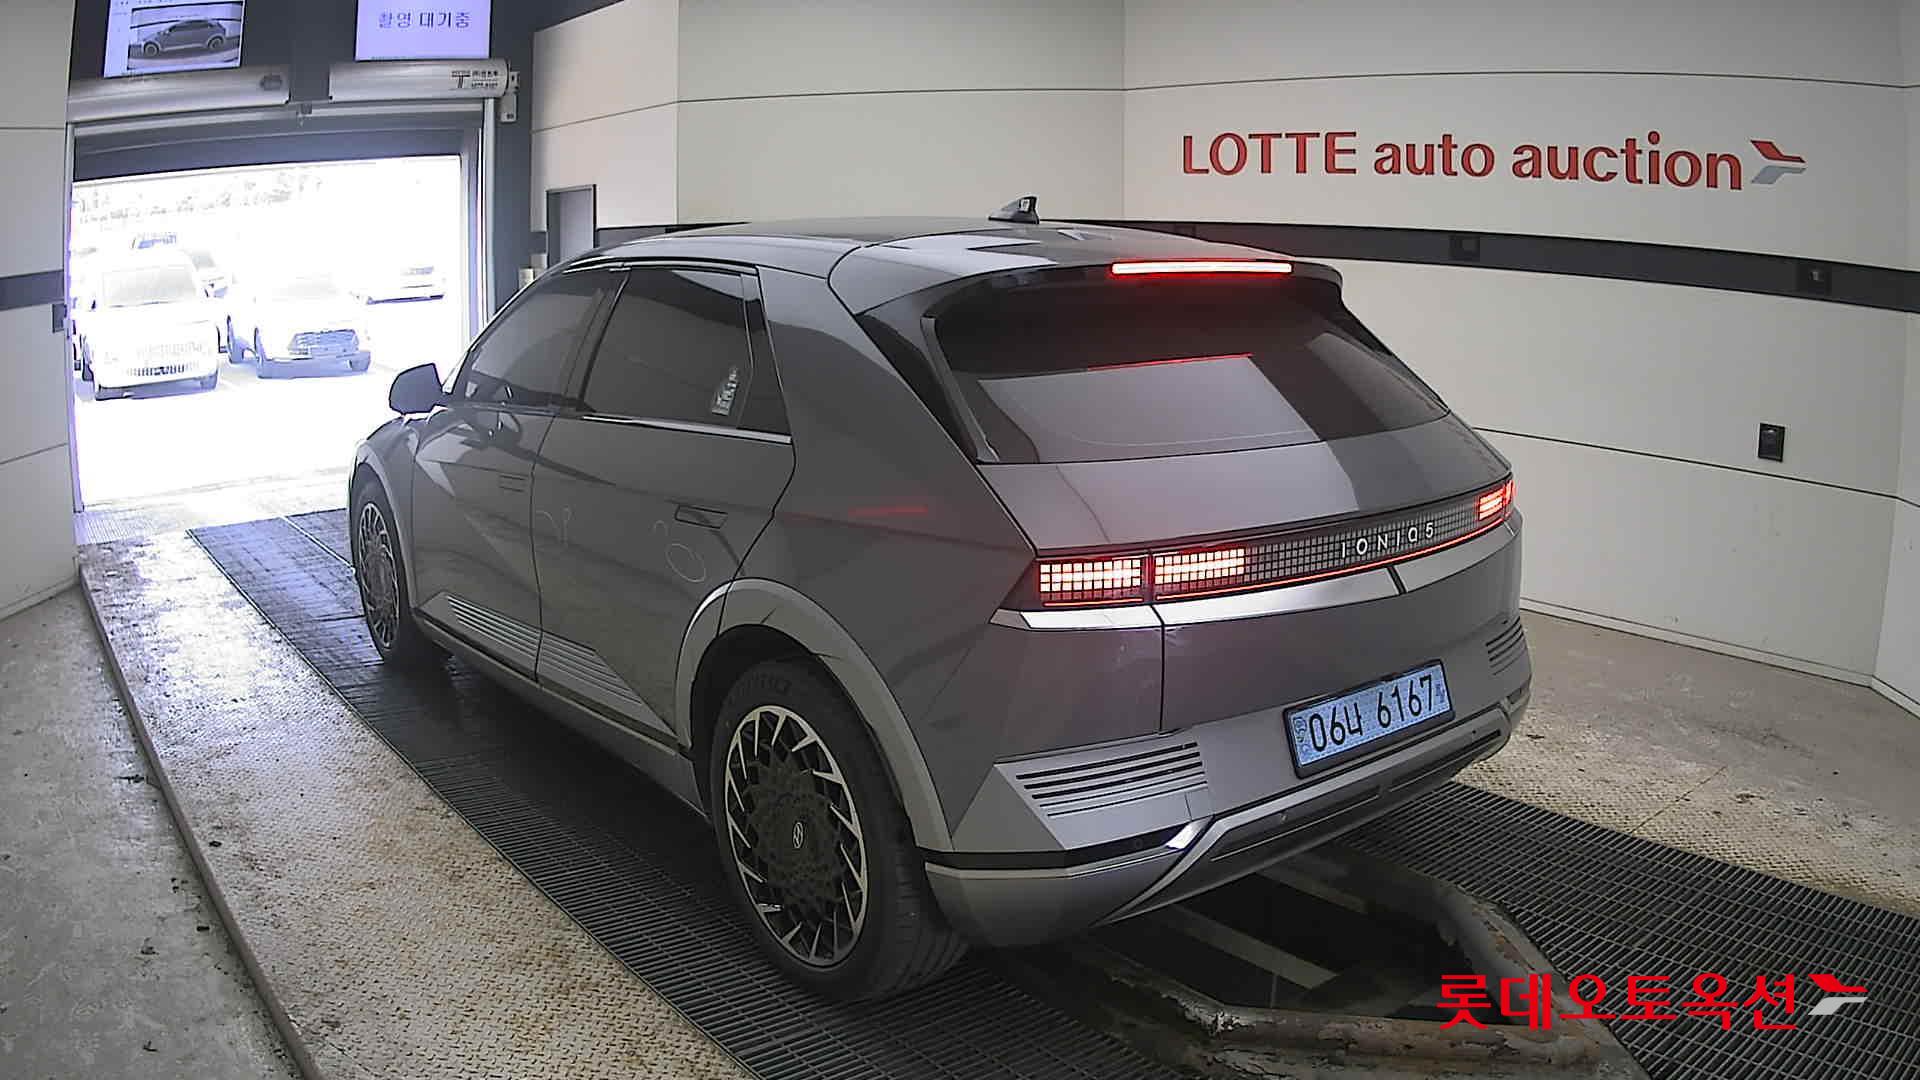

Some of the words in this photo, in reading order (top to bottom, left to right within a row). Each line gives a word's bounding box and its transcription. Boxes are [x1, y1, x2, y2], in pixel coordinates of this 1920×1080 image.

[419, 11, 471, 29] 대기중
[1183, 131, 1358, 177] LOTTE
[1374, 134, 1497, 178] auto
[1512, 131, 1743, 190] auction
[1377, 674, 1432, 729] 6167
